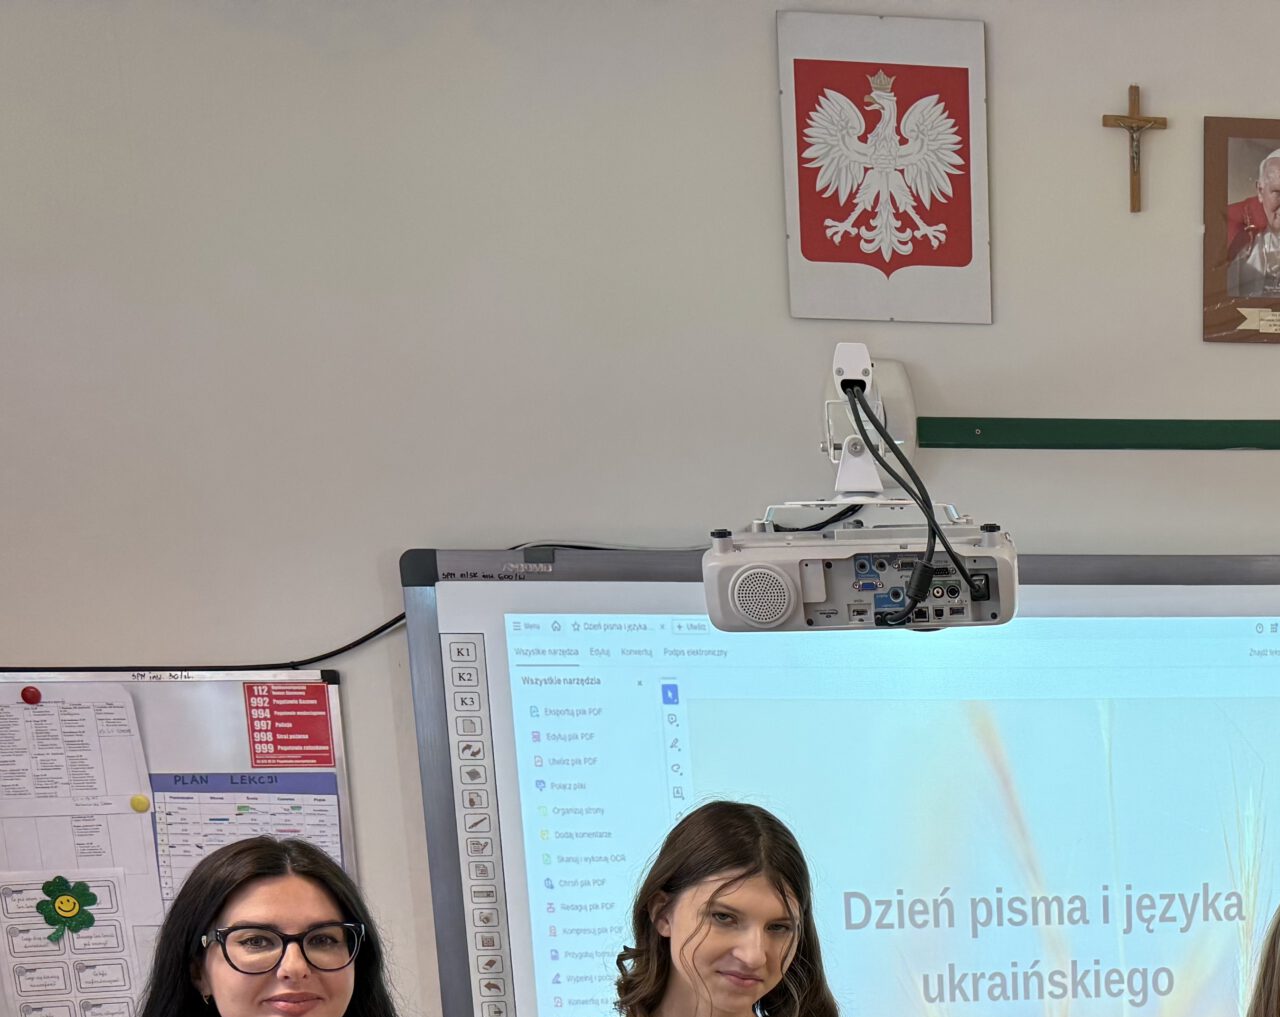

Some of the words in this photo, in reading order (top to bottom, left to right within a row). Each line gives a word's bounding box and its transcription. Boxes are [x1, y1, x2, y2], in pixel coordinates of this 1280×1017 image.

[456, 647, 470, 658] K1
[458, 671, 473, 683] K2
[253, 686, 269, 696] 112
[250, 697, 270, 707] 992
[460, 696, 475, 707] K3
[251, 708, 271, 719] 994
[253, 720, 272, 730] 997
[253, 731, 273, 742] 998
[254, 743, 275, 754] 999
[174, 774, 209, 786] PLAN
[230, 775, 278, 785] LEKCJI
[843, 887, 956, 930] Dzień
[970, 887, 1089, 938] pisma
[1101, 884, 1110, 925] i
[1122, 882, 1246, 935] języka
[921, 958, 1175, 1008] ukraińskiego
